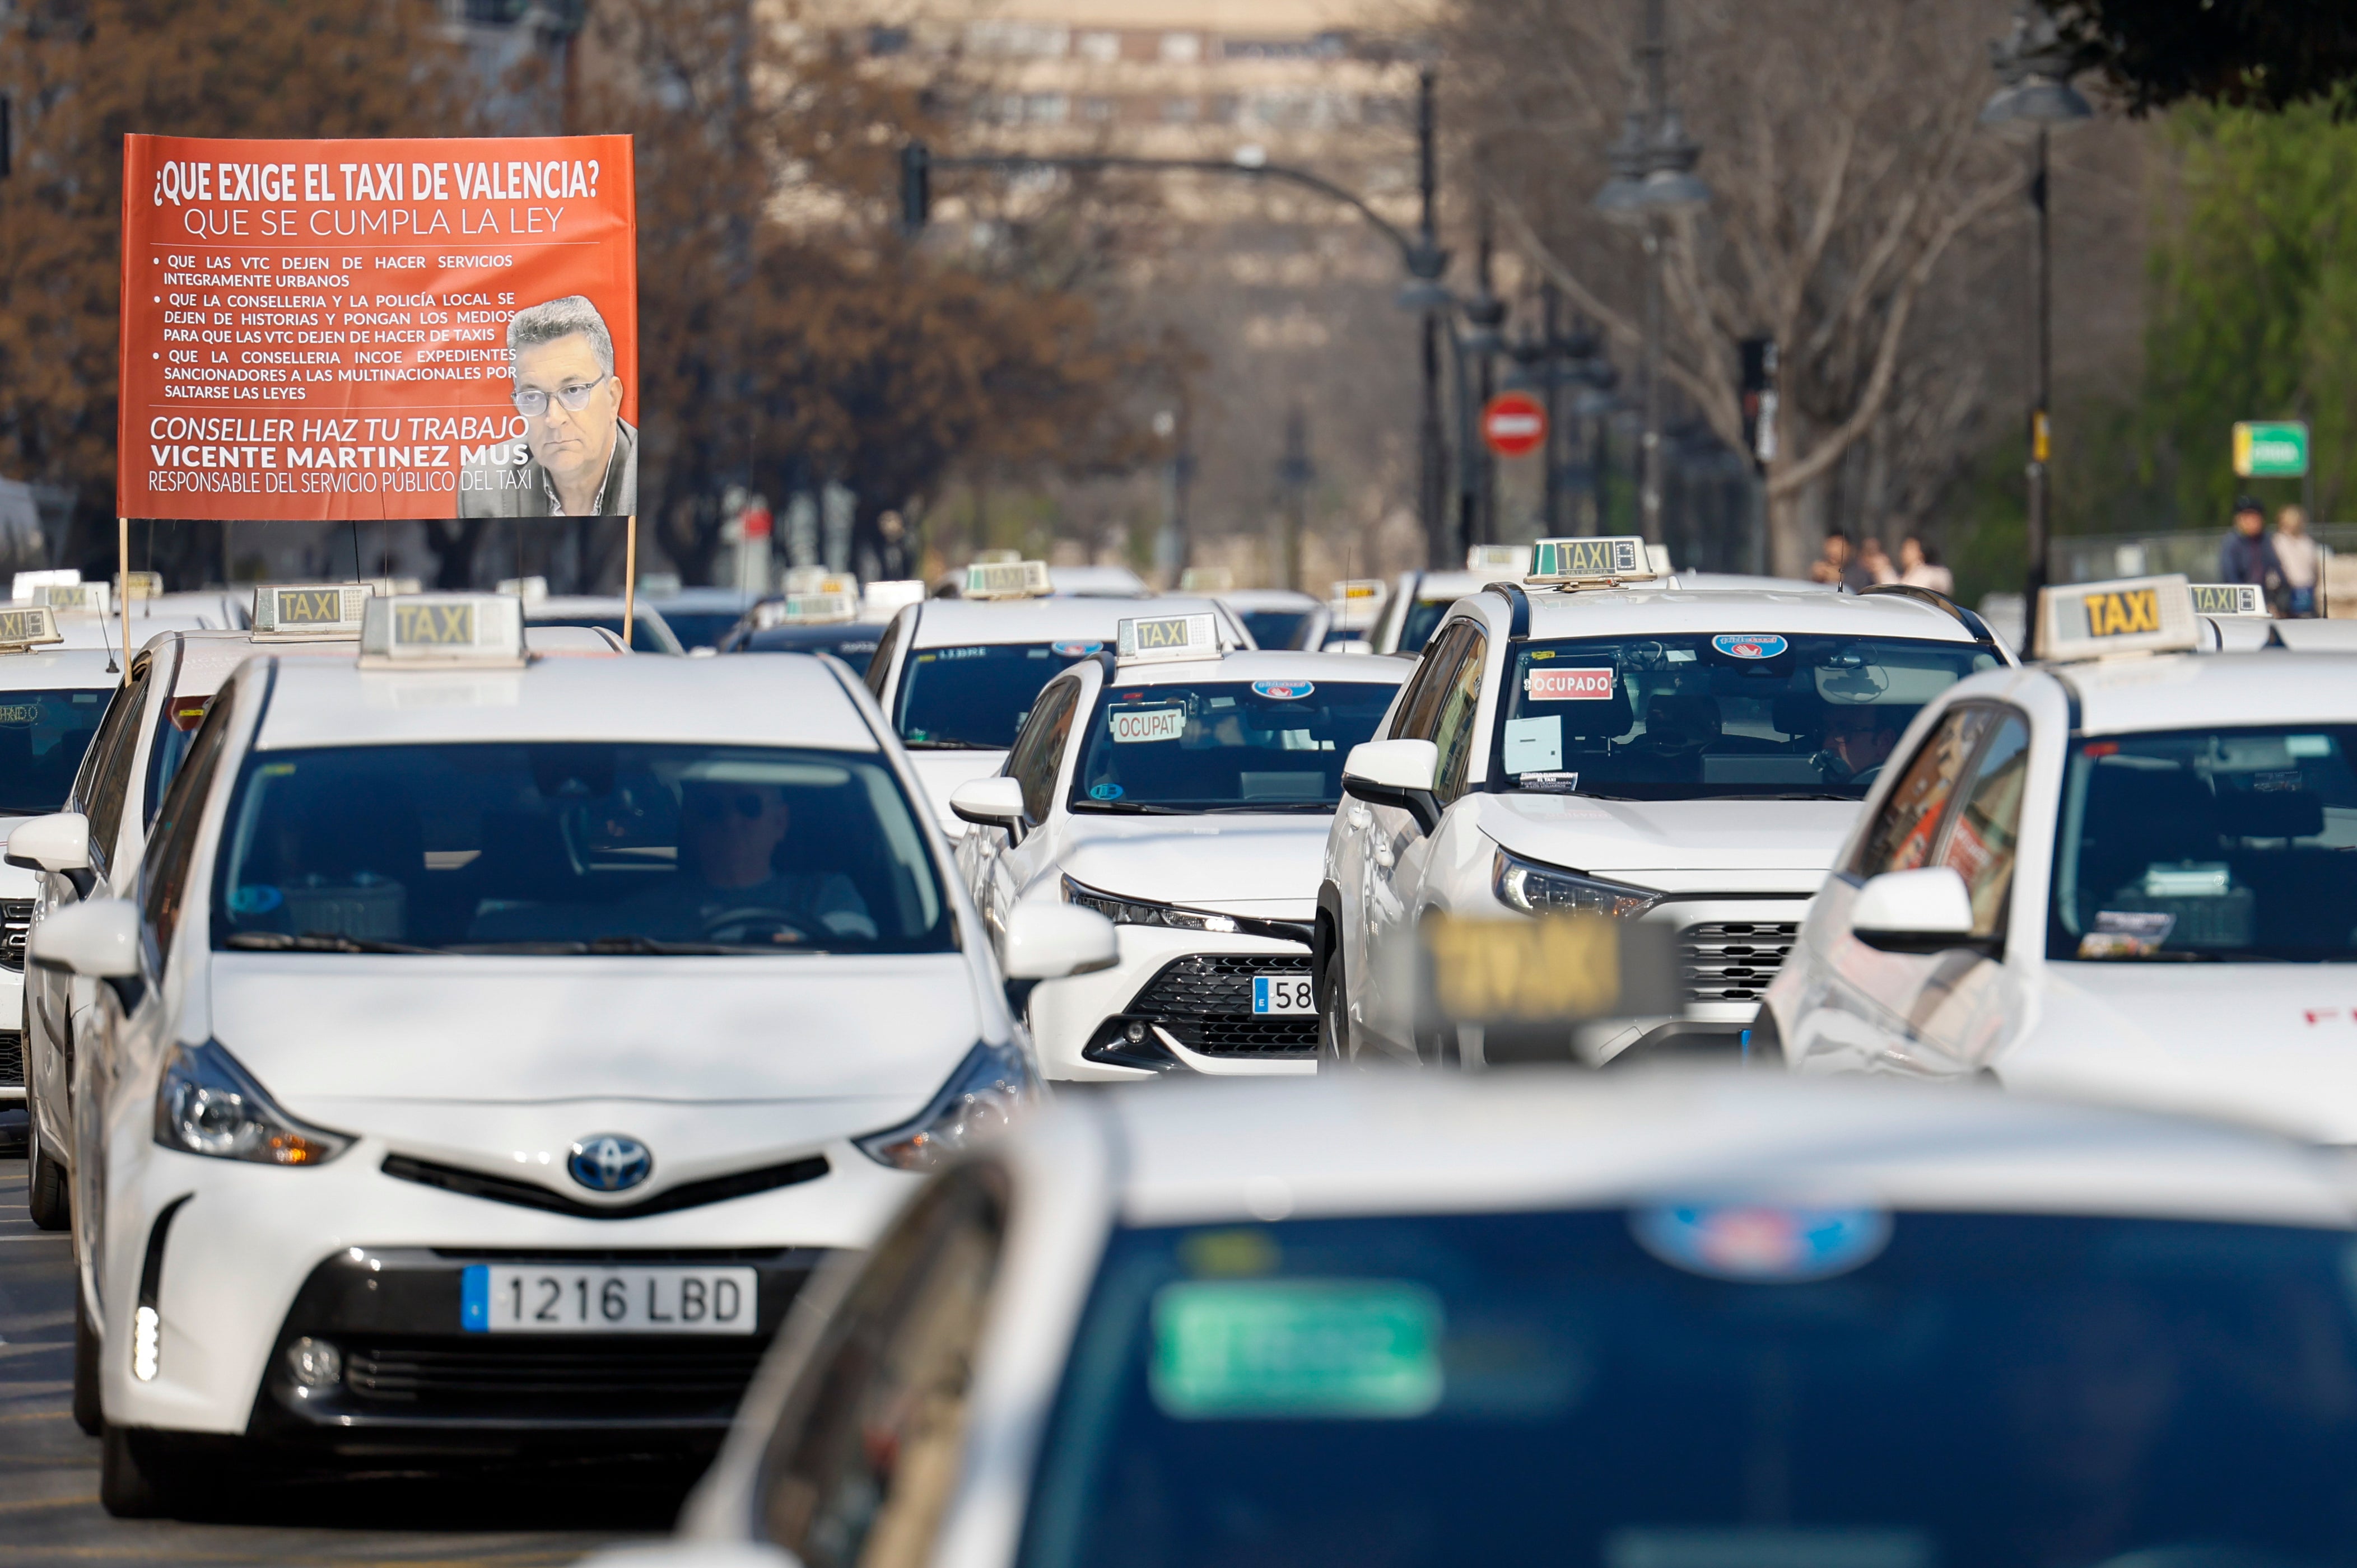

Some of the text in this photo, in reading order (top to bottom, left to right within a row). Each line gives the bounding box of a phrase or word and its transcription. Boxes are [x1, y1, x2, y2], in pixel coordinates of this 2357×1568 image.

[154, 160, 599, 206] ¿QUE EXIGE EL TAXI DE VALENCIA?
[184, 207, 564, 239] QUE SE CUMPLA LA LEY
[168, 254, 513, 269] QUE LAS VTC DEJEN DE HACER SERVICIOS
[164, 273, 350, 287] INTEGRAMENTE URBANOS
[169, 291, 515, 308] QUE LA CONSELLERIA Y LA POLICÍA LOCAL SE
[165, 310, 515, 326] DEJEN DE HISTORIAS Y PONGAN LOS MEDIOS
[164, 328, 495, 344] PARA QUE LAS VTC DEJEN DE HACER DE TAXIS
[169, 348, 516, 364] QUE LA CONSELLERIA INCOE EXPEDIENTES
[165, 366, 517, 381] SANCIONADORES A LAS MULTINACIONALES POR
[165, 385, 306, 399] SALTARSE LAS LEYES
[151, 416, 529, 442] CONSELLER HAZ TU TRABAJO
[151, 444, 528, 468] VICENTE MARTINEZ MUS
[149, 466, 532, 493] RESPONSABLE DEL SERVICIO PÚBLICO DEL TAXI
[1561, 543, 1611, 569] TAXI
[280, 592, 339, 621] TAXI
[2194, 587, 2235, 609] TAXI
[0, 612, 23, 636] XI
[396, 605, 473, 643] TAXI
[2084, 589, 2159, 636] TAXI
[1138, 621, 1187, 647] TAXI
[1534, 676, 1609, 692] OCUPADO
[1119, 713, 1177, 738] OCUPAT
[511, 1276, 740, 1323] 1216 LBD
